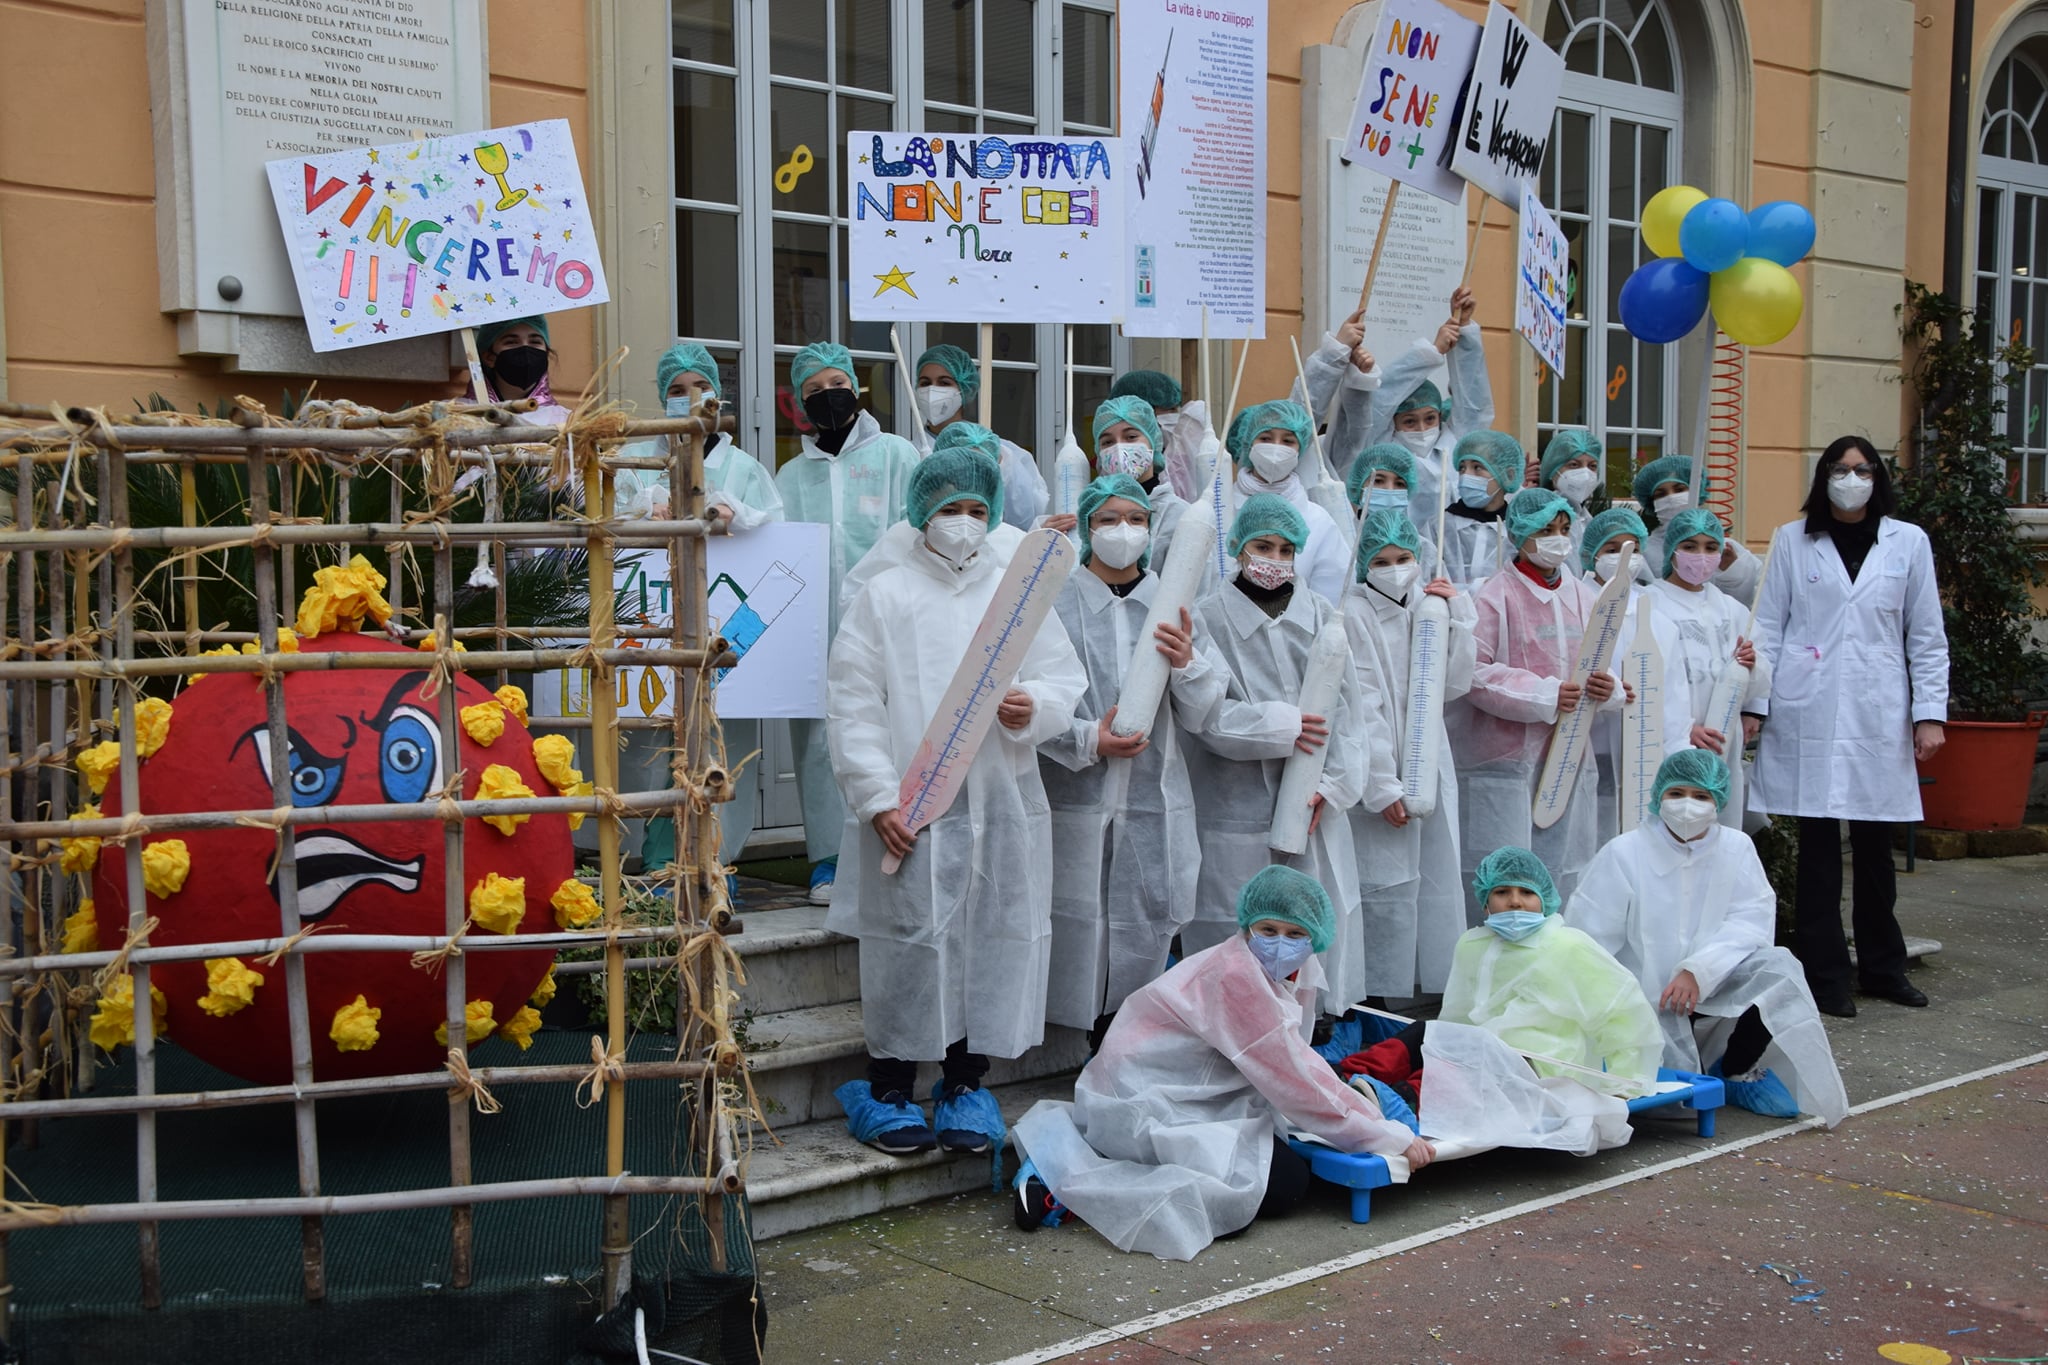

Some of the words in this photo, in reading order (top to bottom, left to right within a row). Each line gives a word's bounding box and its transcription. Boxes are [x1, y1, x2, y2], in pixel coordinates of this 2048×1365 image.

[216, 1, 248, 14] DELLA
[251, 6, 303, 22] RELIGIONE
[306, 15, 336, 27] DELLA
[339, 20, 372, 34] PATRIA
[376, 26, 404, 38] DELLA
[407, 31, 450, 46] FAMIGLIA
[326, 4, 348, 15] AGLI
[352, 9, 391, 22] ANTICHI
[394, 16, 423, 28] AMORI
[1166, 0, 1176, 13] La
[1179, 3, 1194, 16] vita
[1196, 5, 1202, 18] è
[1204, 10, 1220, 21] uno
[312, 30, 372, 47] CONSACRATI
[312, 45, 364, 60] SACRIFICIO
[367, 53, 385, 64] CHE
[388, 57, 396, 65] LI
[1387, 18, 1440, 61] NON
[1500, 18, 1530, 90] W
[237, 63, 247, 72] IL
[250, 65, 278, 76] NOME
[281, 69, 286, 78] E
[289, 70, 302, 80] LA
[305, 73, 348, 87] MEMORIA
[352, 79, 368, 89] DEI
[371, 82, 404, 94] NOSTRI
[406, 87, 442, 100] CADUTI
[324, 61, 361, 74] VIVONO
[226, 91, 246, 101] DEL
[248, 93, 287, 106] DOVERE
[290, 99, 340, 114] COMPIUTO
[342, 106, 370, 118] DEGLI
[373, 110, 403, 122] IDEALI
[406, 115, 454, 129] AFFERMATI
[310, 88, 340, 100] NELLA
[343, 92, 378, 105] GLORIA
[236, 107, 268, 120] DELLA
[270, 112, 320, 126] GIUSTIZIA
[323, 118, 384, 134] SUGGELLATA
[386, 127, 406, 136] CON
[317, 132, 334, 143] PER
[337, 135, 370, 146] SEMPRE
[946, 136, 1111, 180] NOTTATA
[857, 180, 963, 222] NON
[304, 162, 594, 300] VINCEREMO
